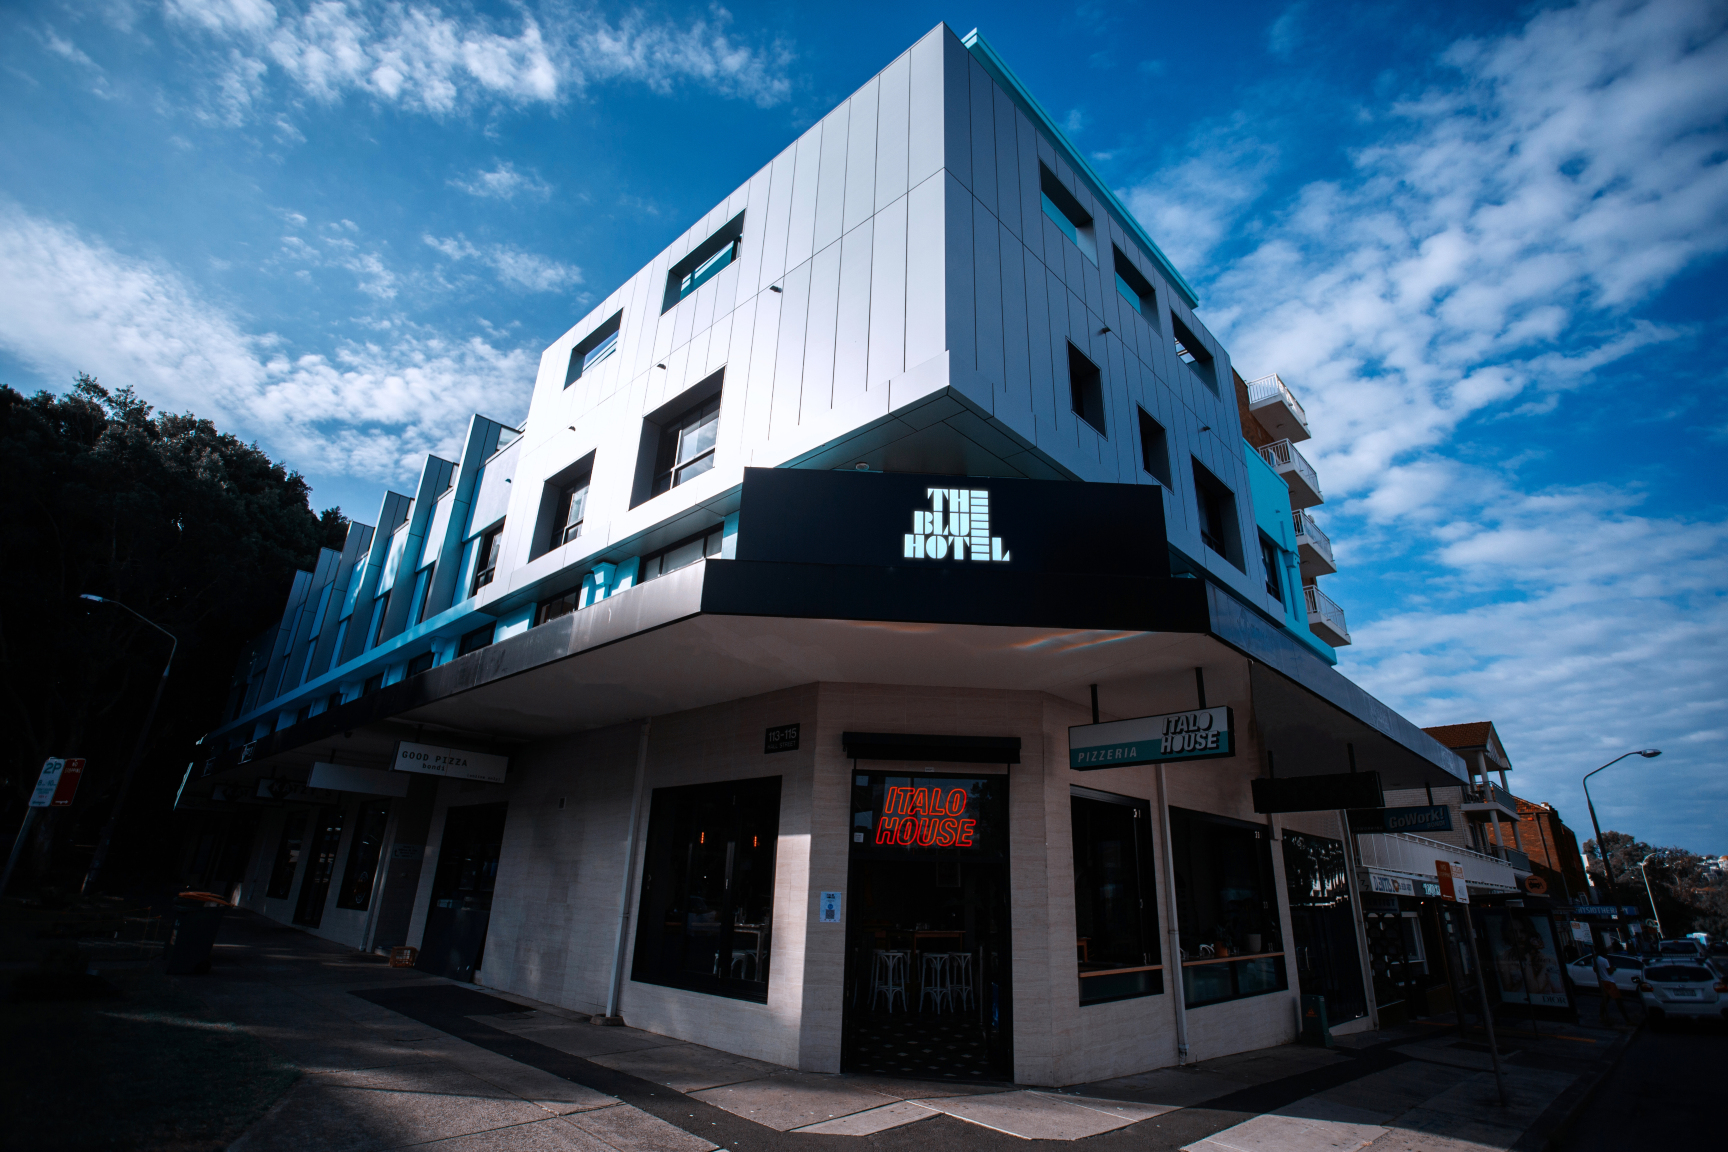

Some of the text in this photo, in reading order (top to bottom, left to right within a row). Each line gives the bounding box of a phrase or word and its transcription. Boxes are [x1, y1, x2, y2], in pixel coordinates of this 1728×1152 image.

[927, 488, 989, 513] THE
[914, 511, 990, 537] BLUE
[904, 534, 1010, 561] HOTEL
[1162, 712, 1213, 736] ITALO
[768, 727, 797, 742] 113-115
[1160, 730, 1220, 755] HOUSE
[779, 740, 796, 749] STREET
[402, 750, 467, 767] GOOD PIZZA
[1077, 746, 1137, 763] PIZZERIA
[43, 762, 62, 774] 2P
[422, 763, 445, 771] bondi
[885, 786, 968, 817] ITALO
[1388, 807, 1445, 829] GoWork!
[1427, 820, 1446, 829] BONDI
[875, 816, 977, 847] HOUSE
[1575, 905, 1629, 915] HYSIOTHERY
[1541, 995, 1567, 1004] DIOR
